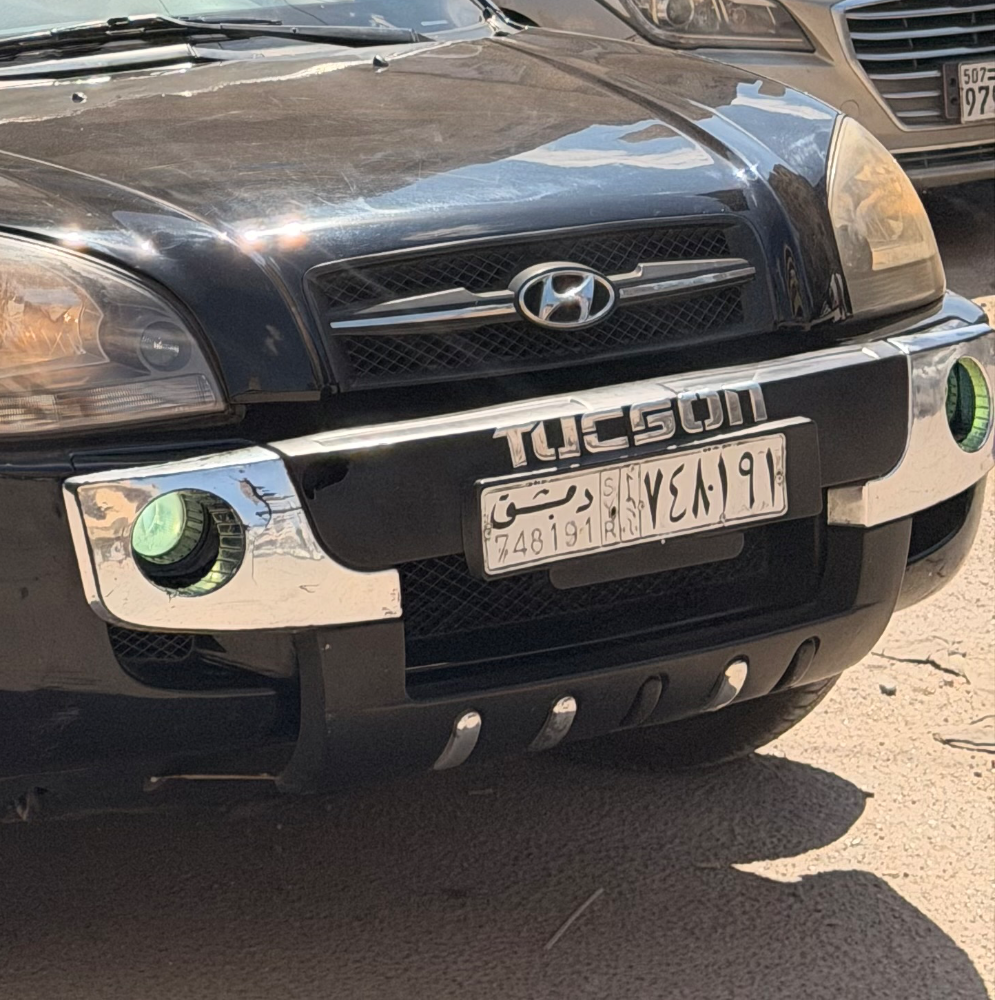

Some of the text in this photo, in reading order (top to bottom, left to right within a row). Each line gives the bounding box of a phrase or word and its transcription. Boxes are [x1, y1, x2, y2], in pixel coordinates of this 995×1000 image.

[965, 85, 995, 117] 97
[492, 381, 768, 468] TUCSON
[490, 484, 594, 530] دمشق
[494, 516, 593, 564] 748191
